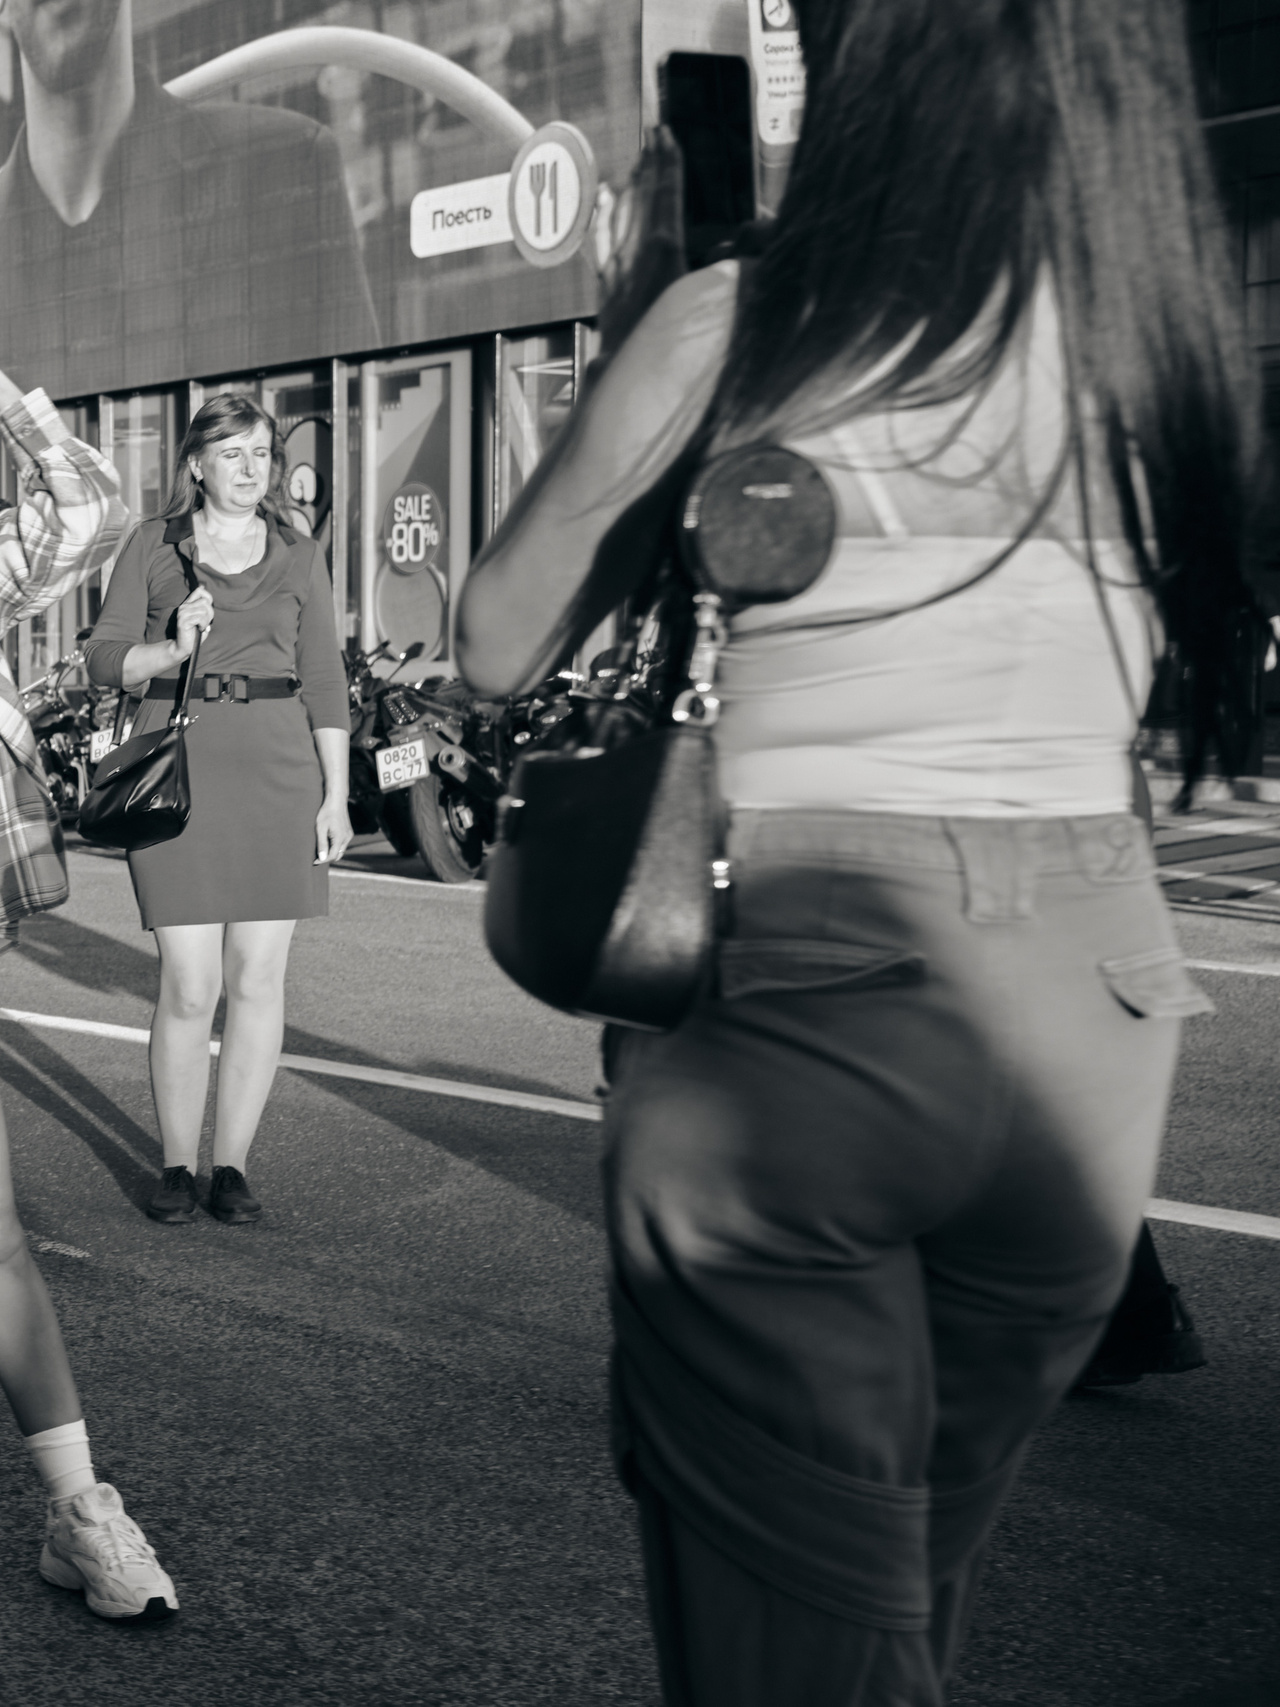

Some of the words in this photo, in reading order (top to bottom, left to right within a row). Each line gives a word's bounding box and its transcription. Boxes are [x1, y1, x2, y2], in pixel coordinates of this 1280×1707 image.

[432, 206, 492, 231] Поесть
[394, 494, 431, 522] SALE
[384, 745, 417, 765] 0820
[407, 760, 422, 777] 77
